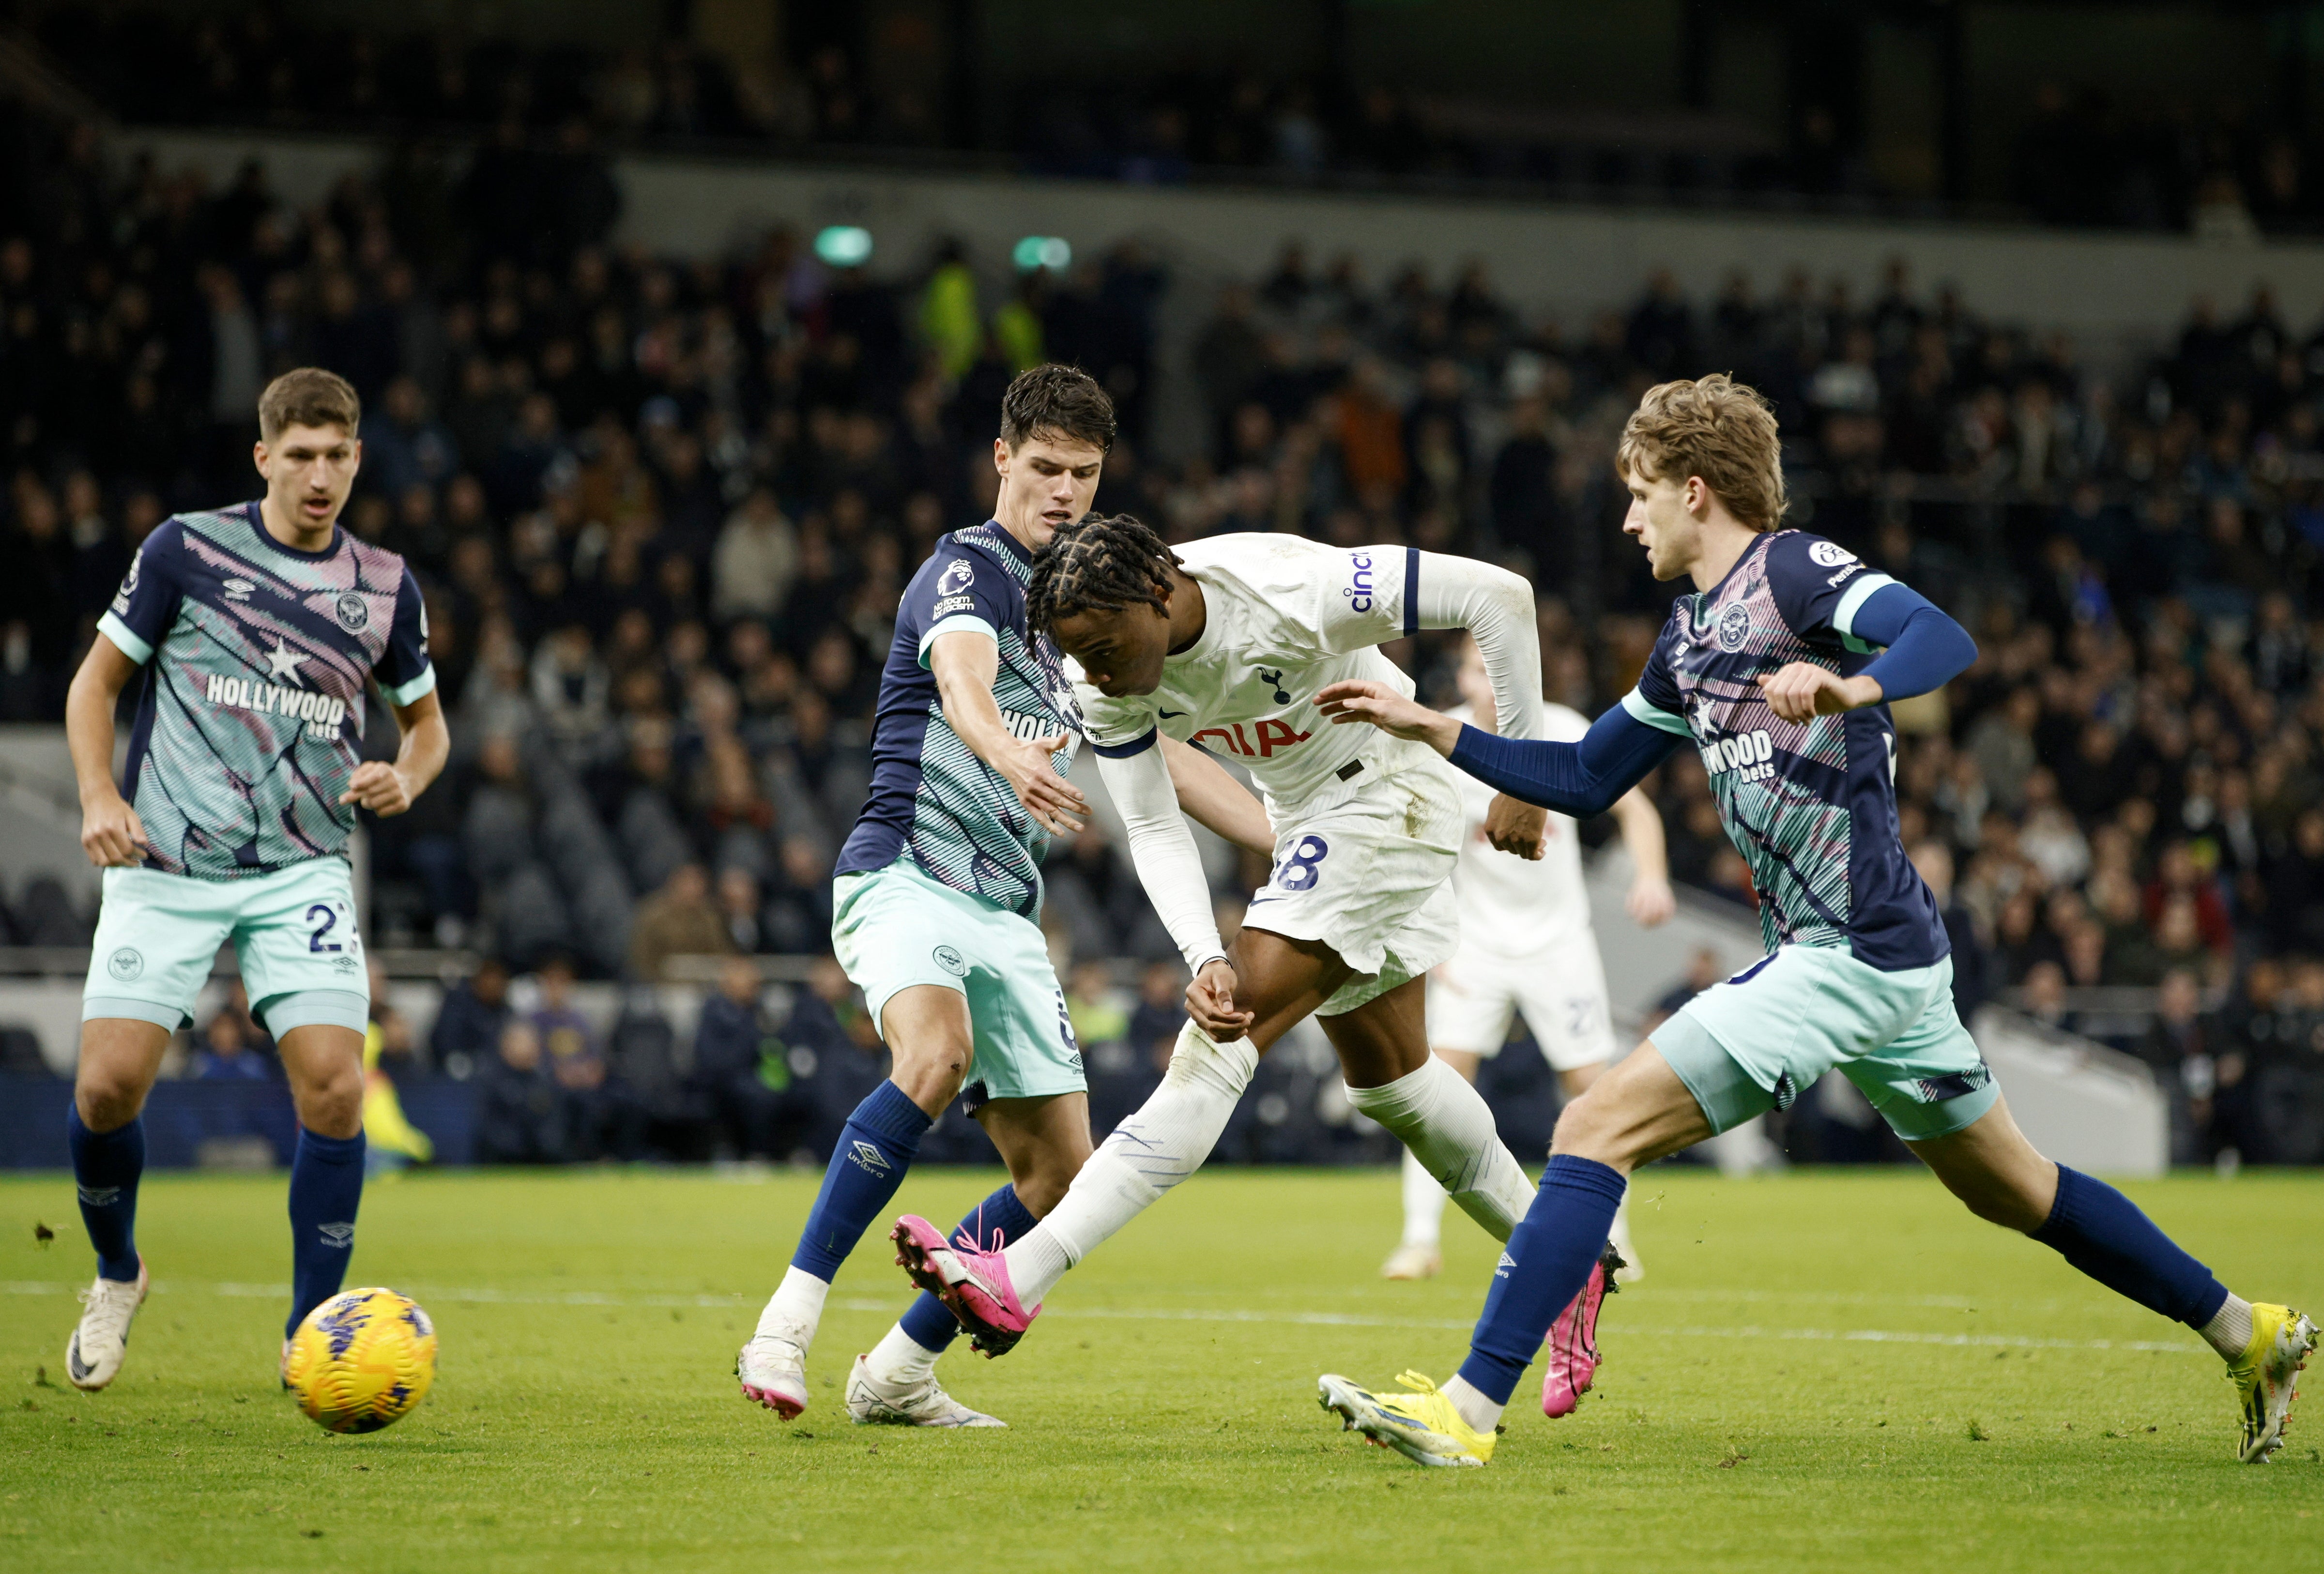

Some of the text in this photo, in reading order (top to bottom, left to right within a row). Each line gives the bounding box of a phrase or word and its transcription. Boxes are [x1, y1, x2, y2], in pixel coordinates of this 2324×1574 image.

[933, 602, 943, 613] No
[943, 603, 974, 614] racism
[1723, 606, 1746, 622] BRENTFORD
[206, 673, 345, 726] HOLLYWOOD
[307, 719, 340, 741] bets
[1738, 763, 1775, 784] bets
[1269, 835, 1329, 891] 8
[847, 1151, 884, 1179] umbro
[1495, 1267, 1510, 1279] bro
